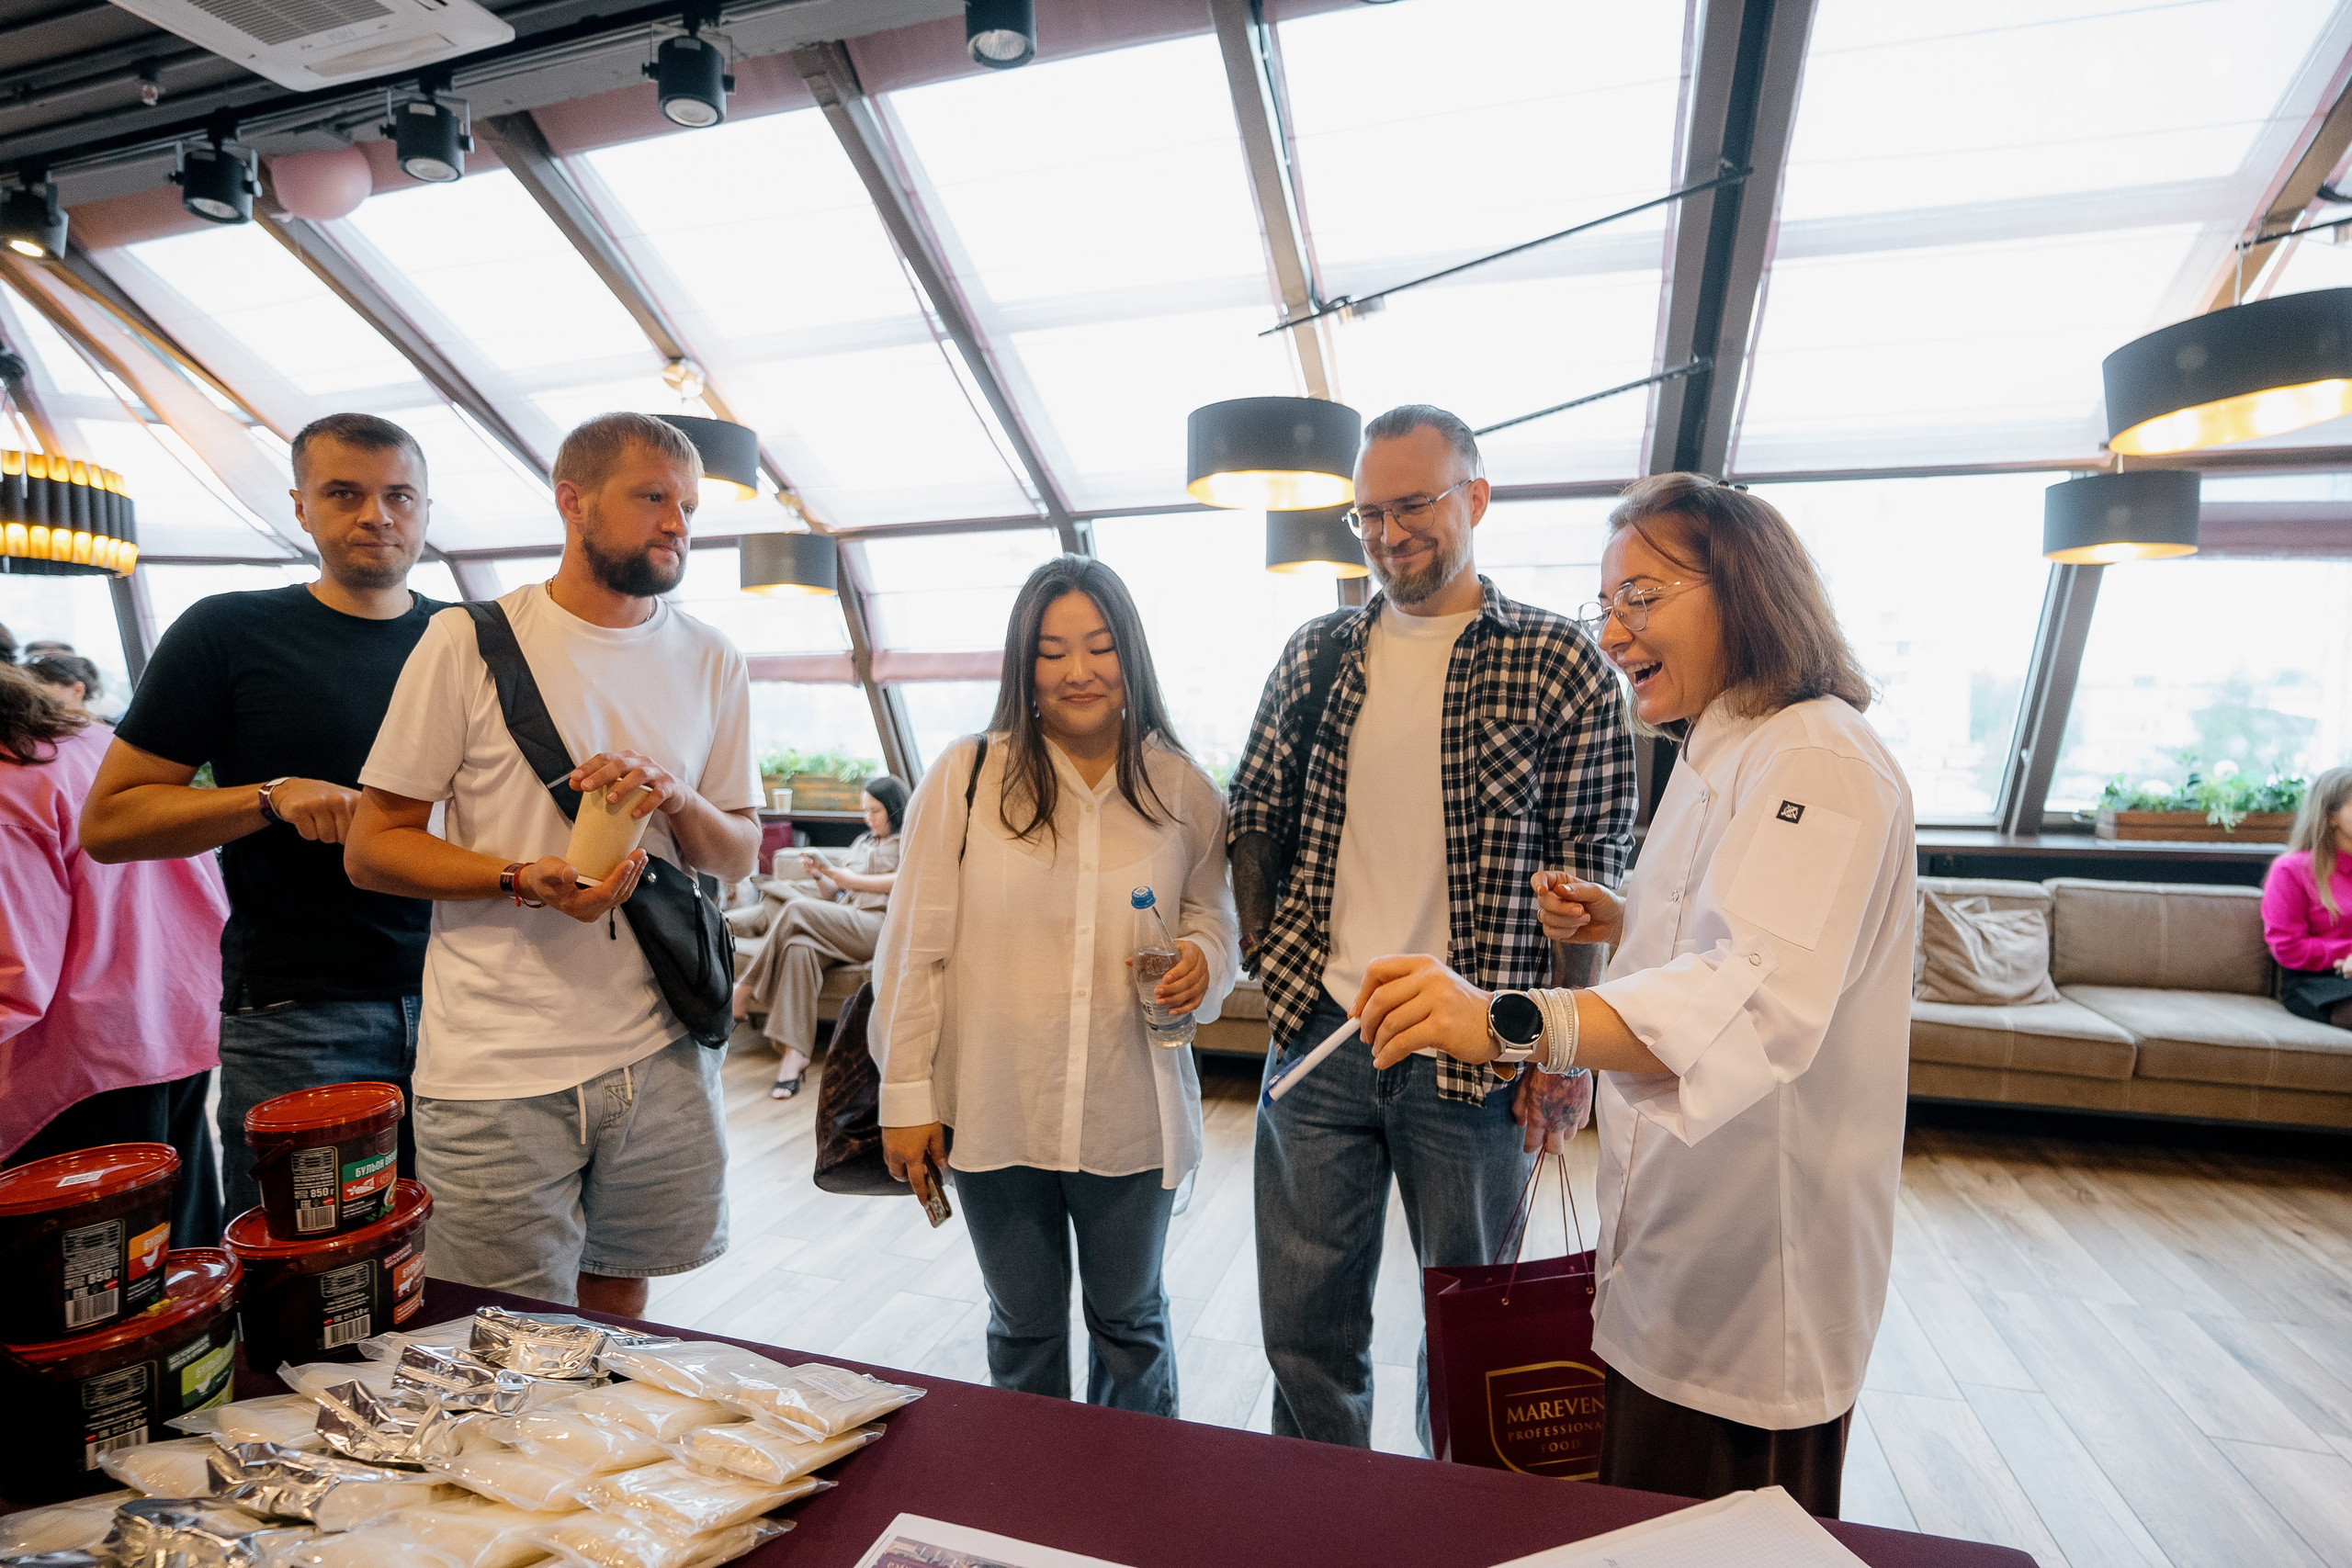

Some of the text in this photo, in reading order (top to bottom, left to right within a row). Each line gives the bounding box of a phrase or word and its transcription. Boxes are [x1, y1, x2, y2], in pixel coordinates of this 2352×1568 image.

[355, 1158, 385, 1178] БУЛЬОН
[310, 1187, 329, 1198] 850
[87, 1269, 113, 1284] 850
[1507, 1397, 1605, 1424] MAREVEN
[1508, 1421, 1603, 1442] PROFESSIONA
[1542, 1438, 1580, 1453] FOOD
